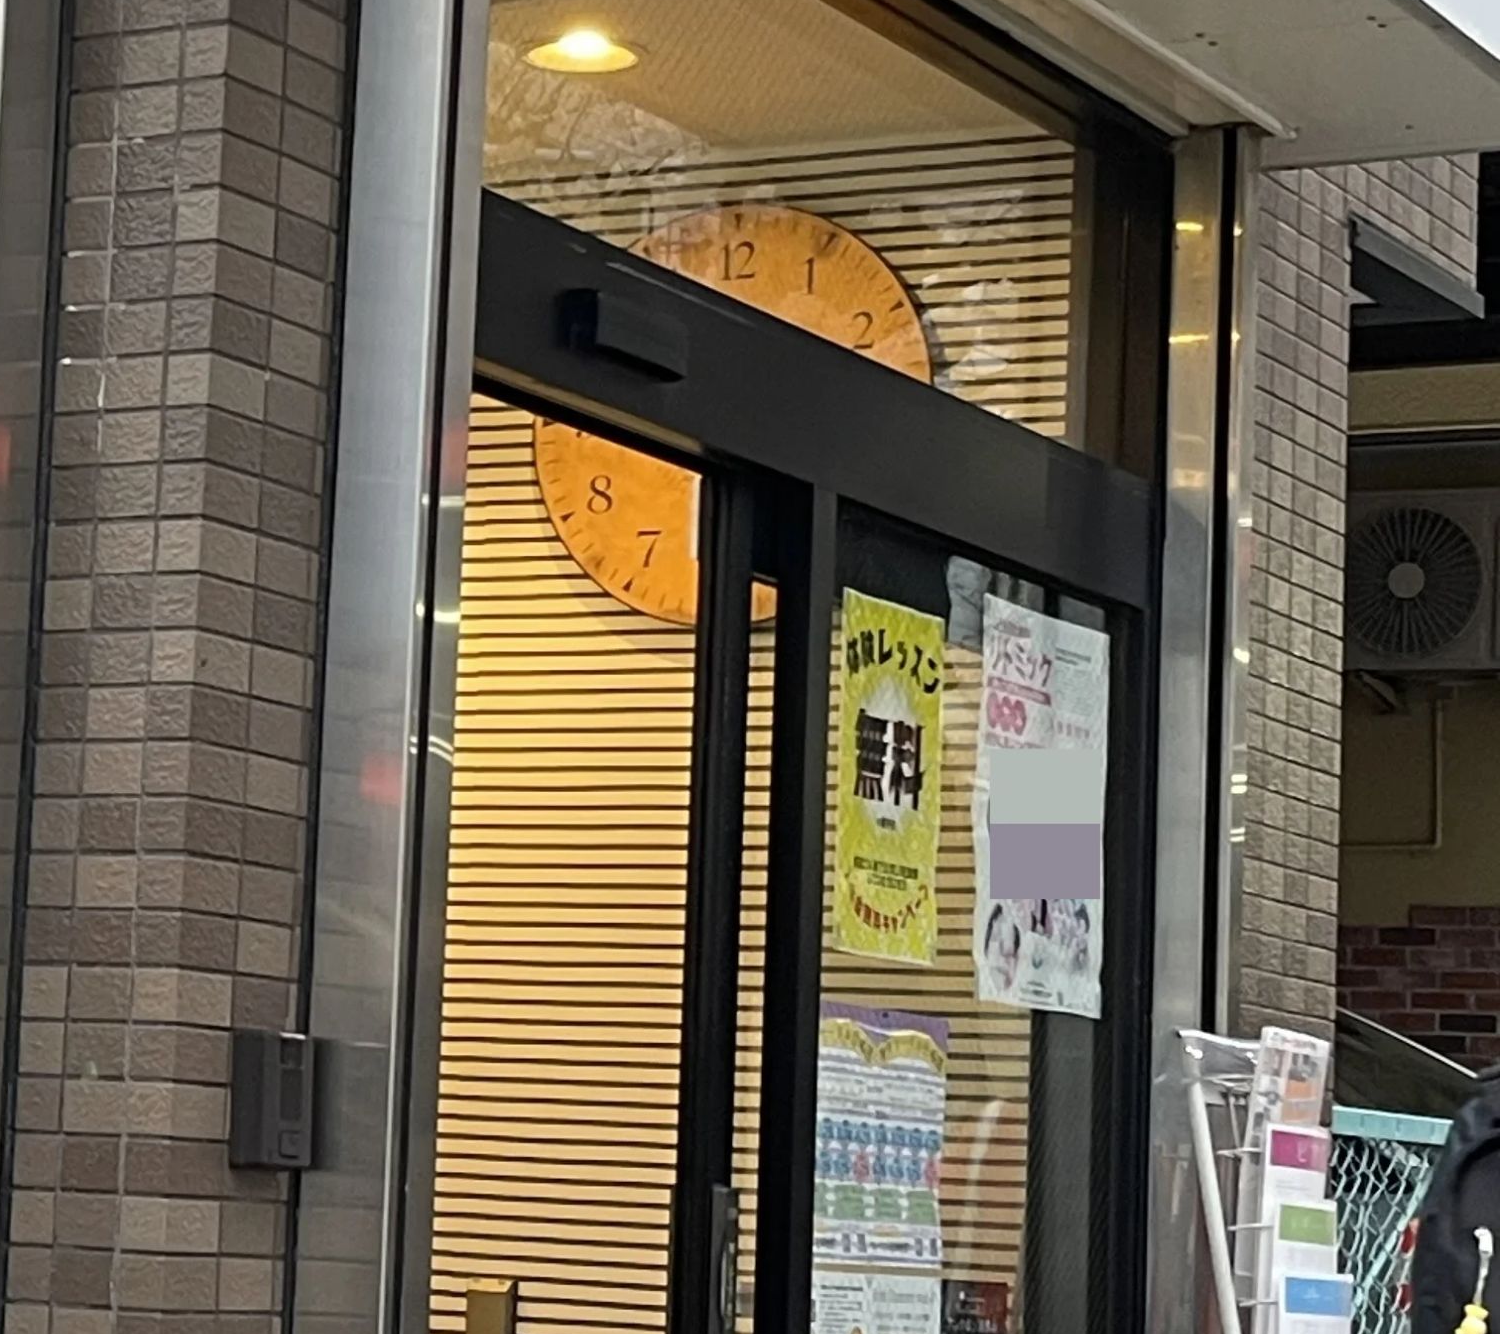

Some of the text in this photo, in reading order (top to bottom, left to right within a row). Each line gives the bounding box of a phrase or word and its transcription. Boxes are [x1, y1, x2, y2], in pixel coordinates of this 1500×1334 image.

[717, 239, 756, 281] 12
[802, 255, 818, 295] 1
[850, 310, 875, 350] 2
[586, 473, 614, 515] 8
[635, 529, 663, 569] 7
[853, 707, 926, 811] 無料
